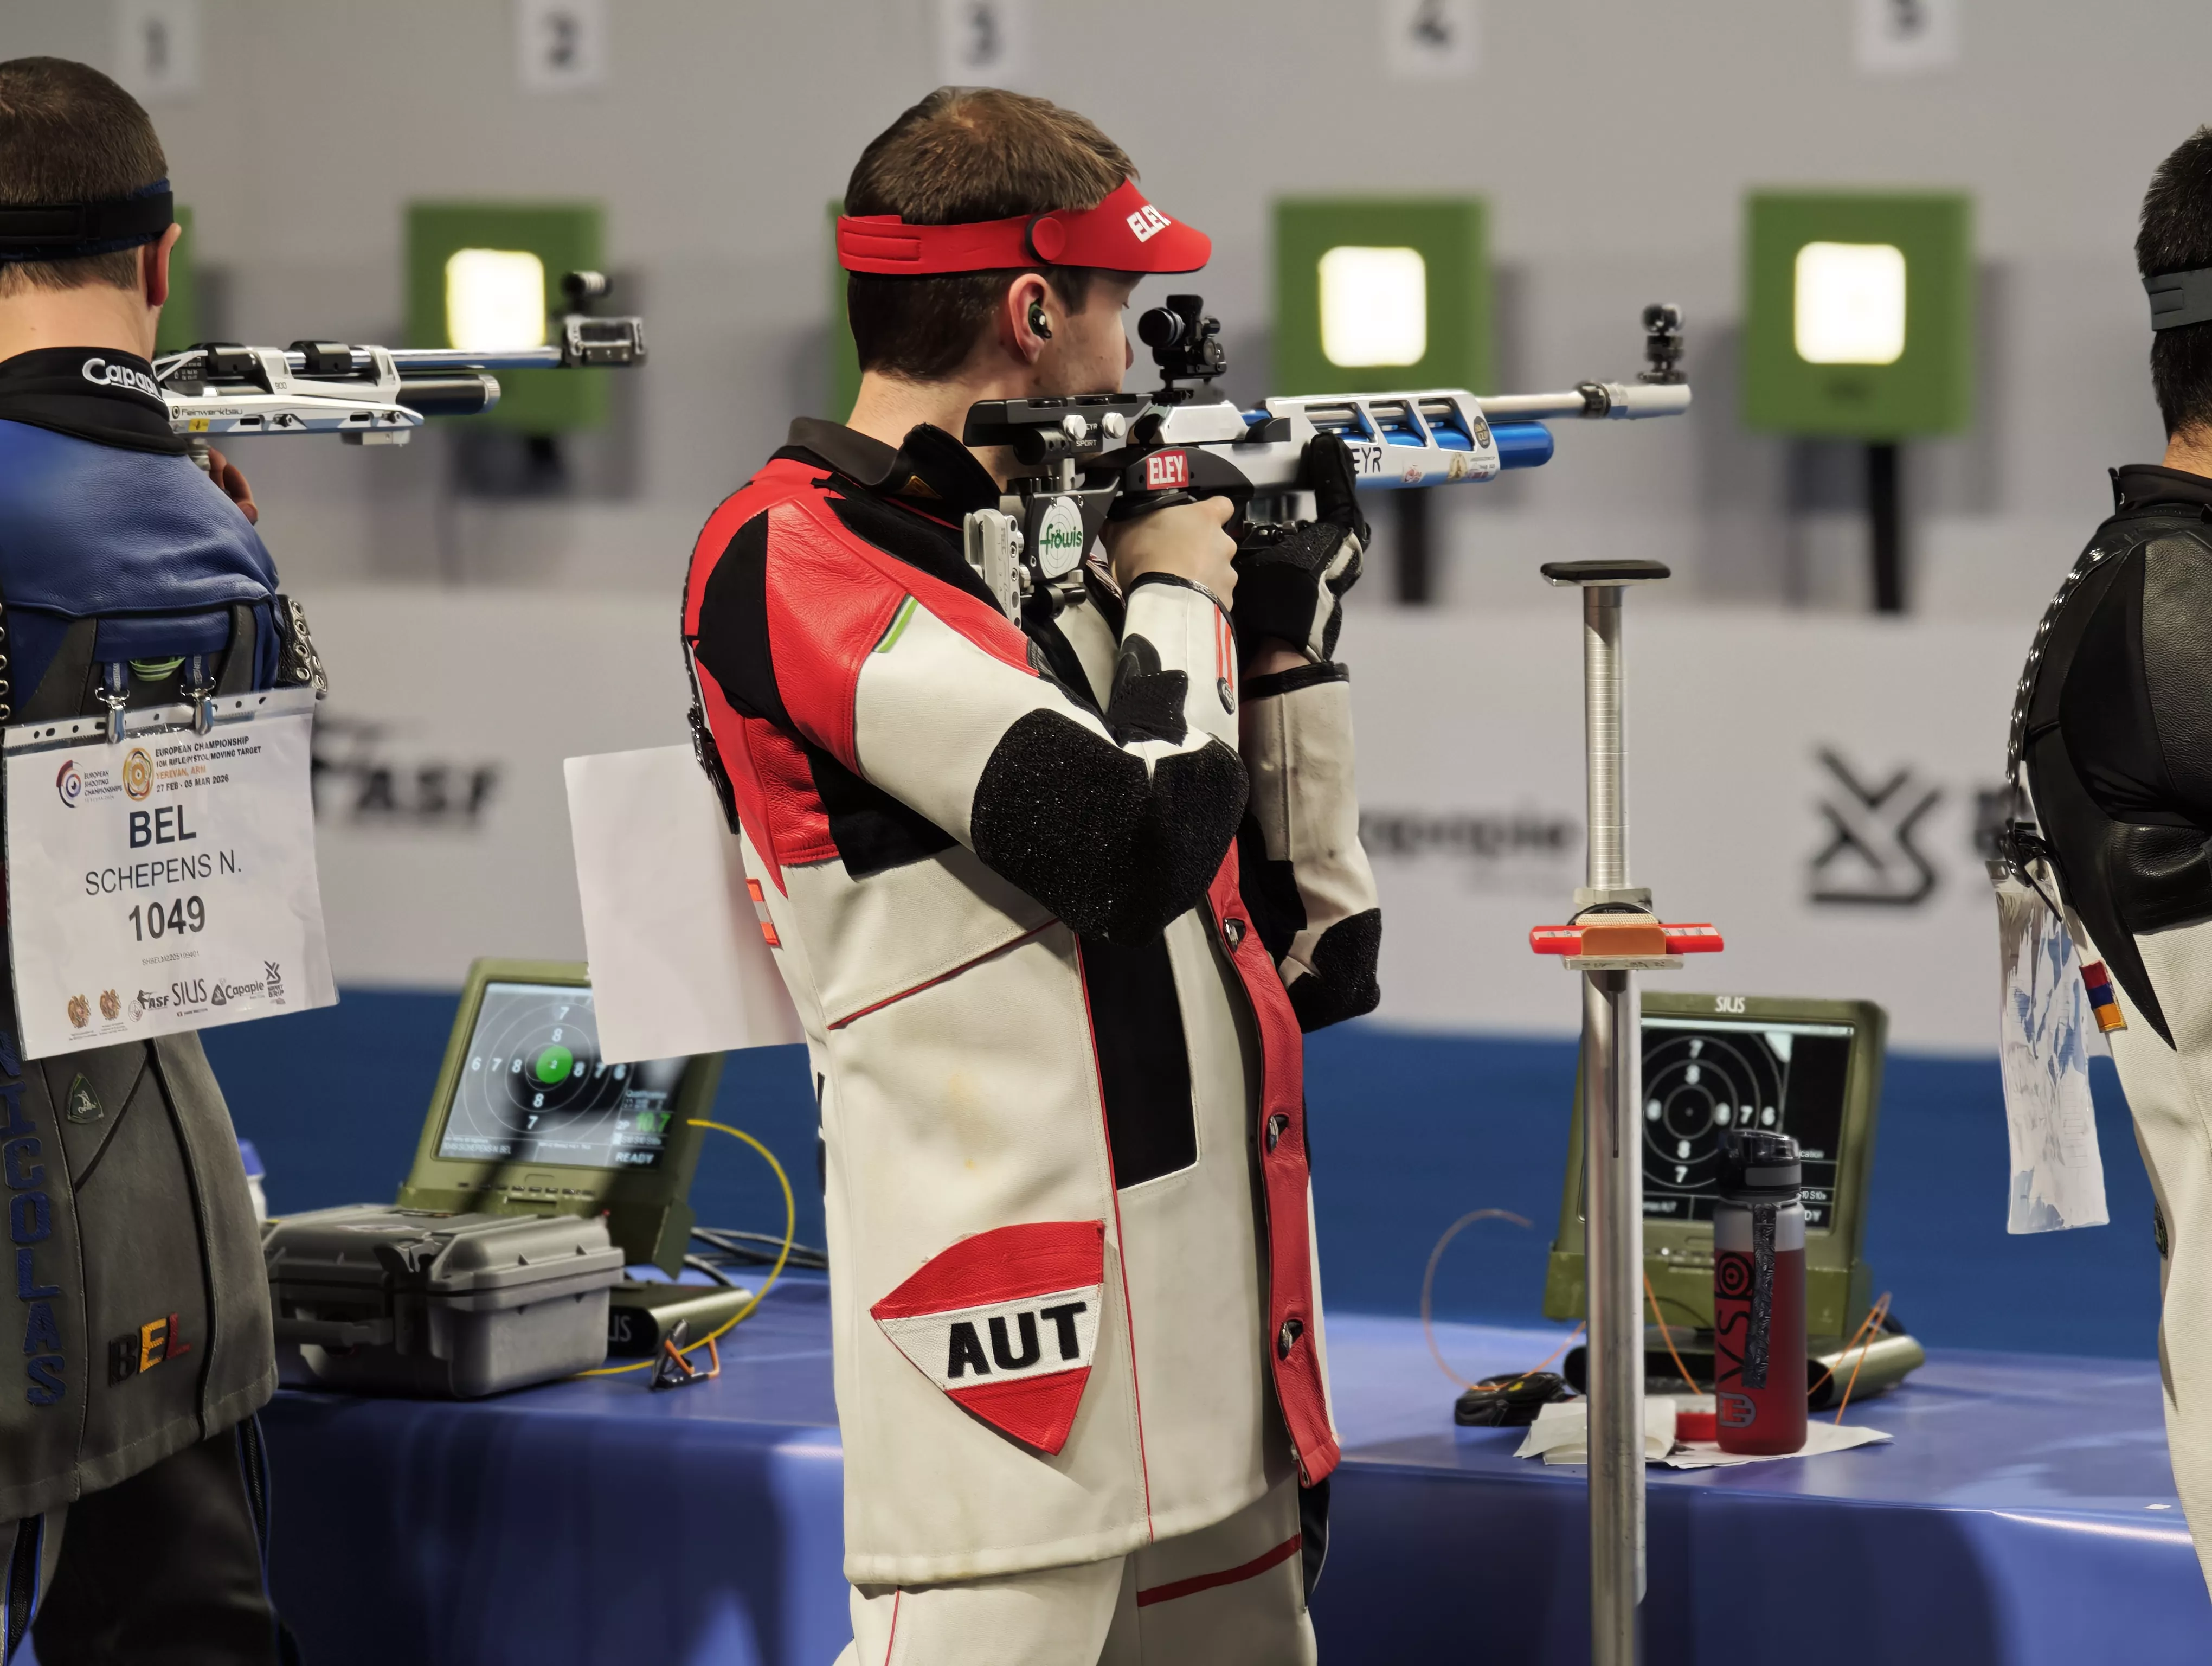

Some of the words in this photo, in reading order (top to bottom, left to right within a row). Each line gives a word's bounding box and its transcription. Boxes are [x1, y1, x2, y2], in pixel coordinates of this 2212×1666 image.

[182, 407, 243, 416] Feinwerkbau
[1148, 455, 1184, 485] ELEY
[1040, 523, 1082, 555] fröwis
[156, 744, 191, 757] EUROPEAN
[194, 735, 249, 752] CHAMPIONSHIP
[156, 760, 167, 768] 10M
[237, 746, 261, 757] TARGET
[166, 781, 179, 791] FEB
[184, 779, 192, 789] 05
[195, 776, 210, 786] MAR
[213, 773, 229, 784] 2026
[130, 805, 197, 849] BEL
[86, 853, 212, 895] SCHEPENS
[220, 849, 242, 875] N.
[128, 895, 205, 941] 1049
[171, 978, 207, 1007] SIUS
[225, 980, 265, 999] Capaple
[558, 1006, 569, 1020] 7
[1715, 996, 1746, 1013] SIUS
[552, 1028, 563, 1042] 8
[1689, 1039, 1703, 1059] 7
[472, 1056, 481, 1071] 6
[492, 1058, 502, 1071] 7
[512, 1059, 522, 1073] 8
[574, 1061, 585, 1077] 8
[533, 1093, 544, 1108] 8
[528, 1116, 538, 1130] 7
[1740, 1105, 1753, 1124] 7
[1761, 1106, 1776, 1126] 6
[615, 1152, 654, 1164] READY
[1675, 1165, 1688, 1183] 7
[109, 1312, 192, 1388] BEL
[948, 1302, 1087, 1379] AUT
